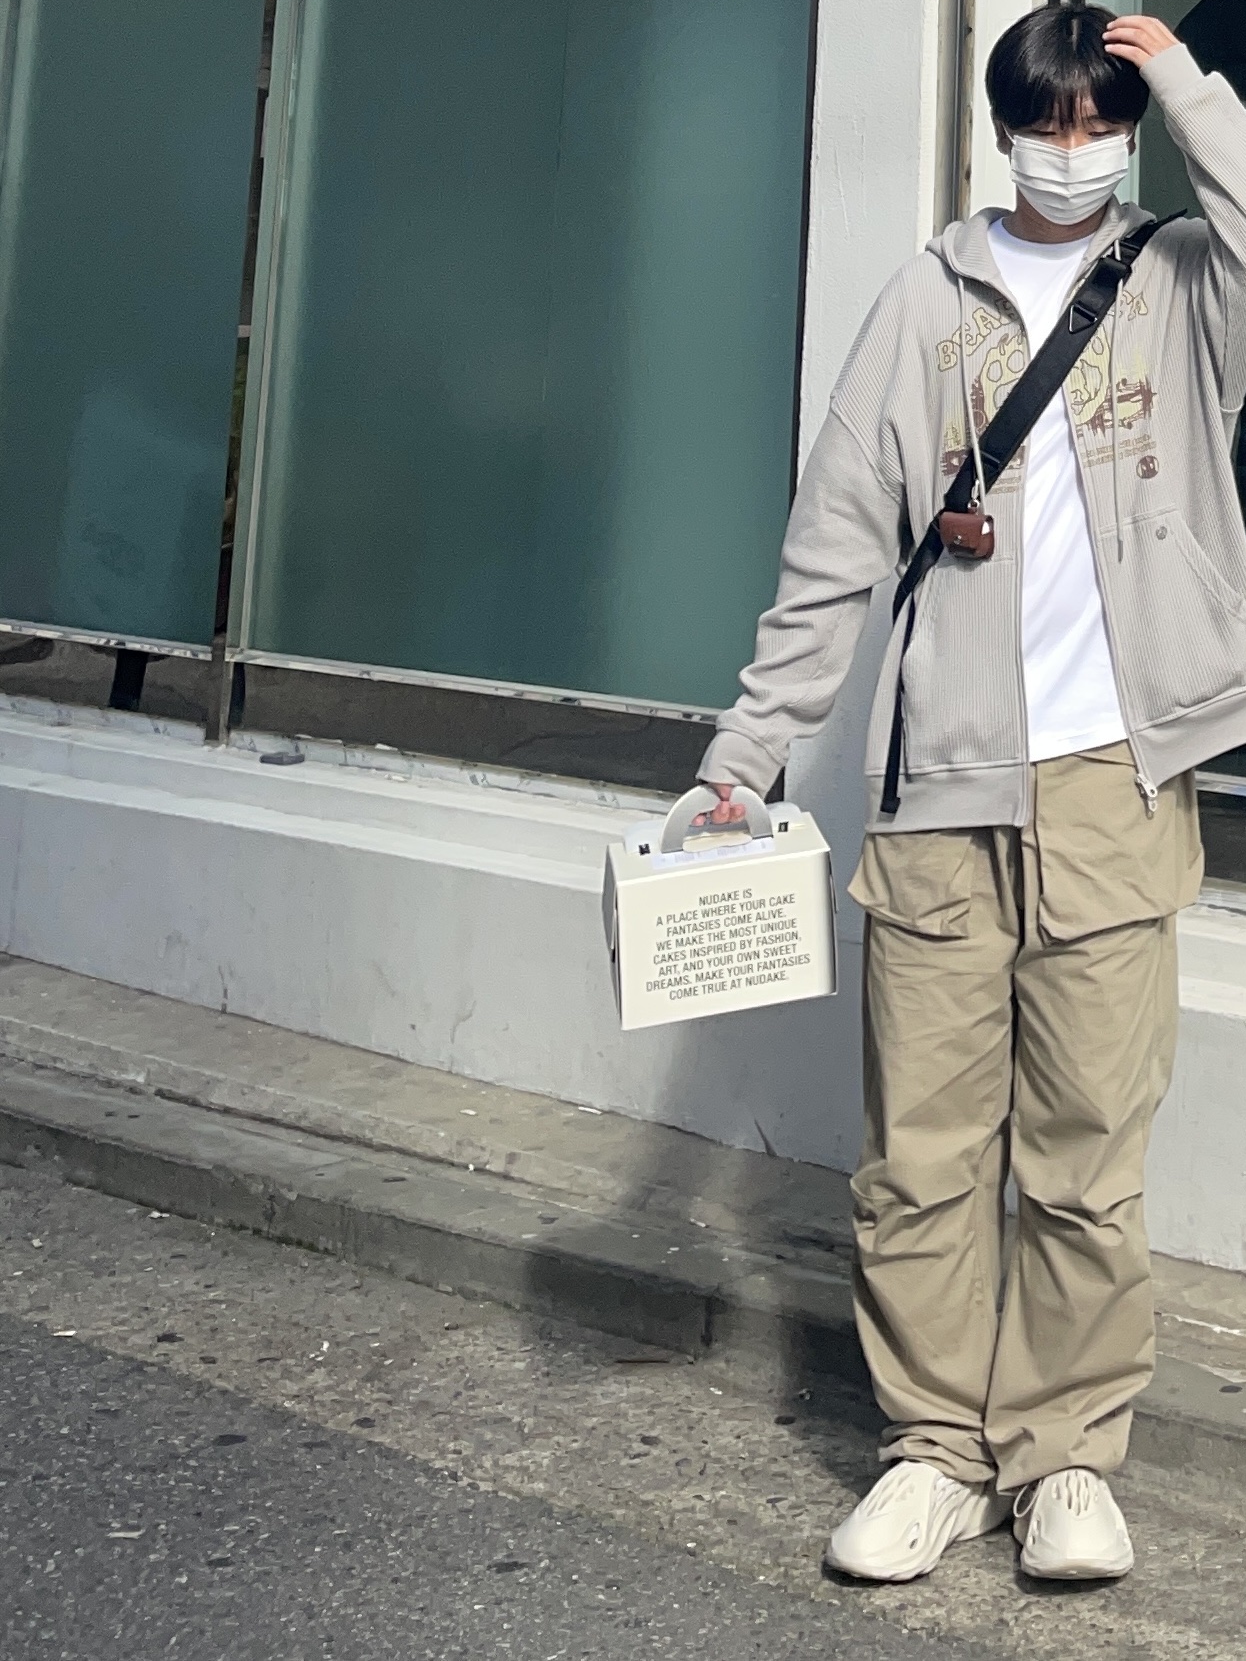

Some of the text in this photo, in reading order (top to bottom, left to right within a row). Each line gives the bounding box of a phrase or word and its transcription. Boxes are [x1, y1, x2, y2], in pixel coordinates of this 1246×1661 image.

[656, 893, 795, 927] A PLACE WHERE YOUR CAKE
[699, 888, 752, 906] NUDAKE IS
[656, 918, 797, 951] WE MAKE THE MOST UNIQUE
[667, 908, 786, 937] FANTASIES COME ALIVE.
[653, 931, 802, 965] CAKES INSPIRED BY FASHION,
[659, 943, 797, 977] ART, AND YOUR OWN SWEET
[646, 953, 811, 992] DREAMS. MAKE YOUR FANTASIES
[669, 970, 790, 1000] COME TRUE AT NUDAKE.
